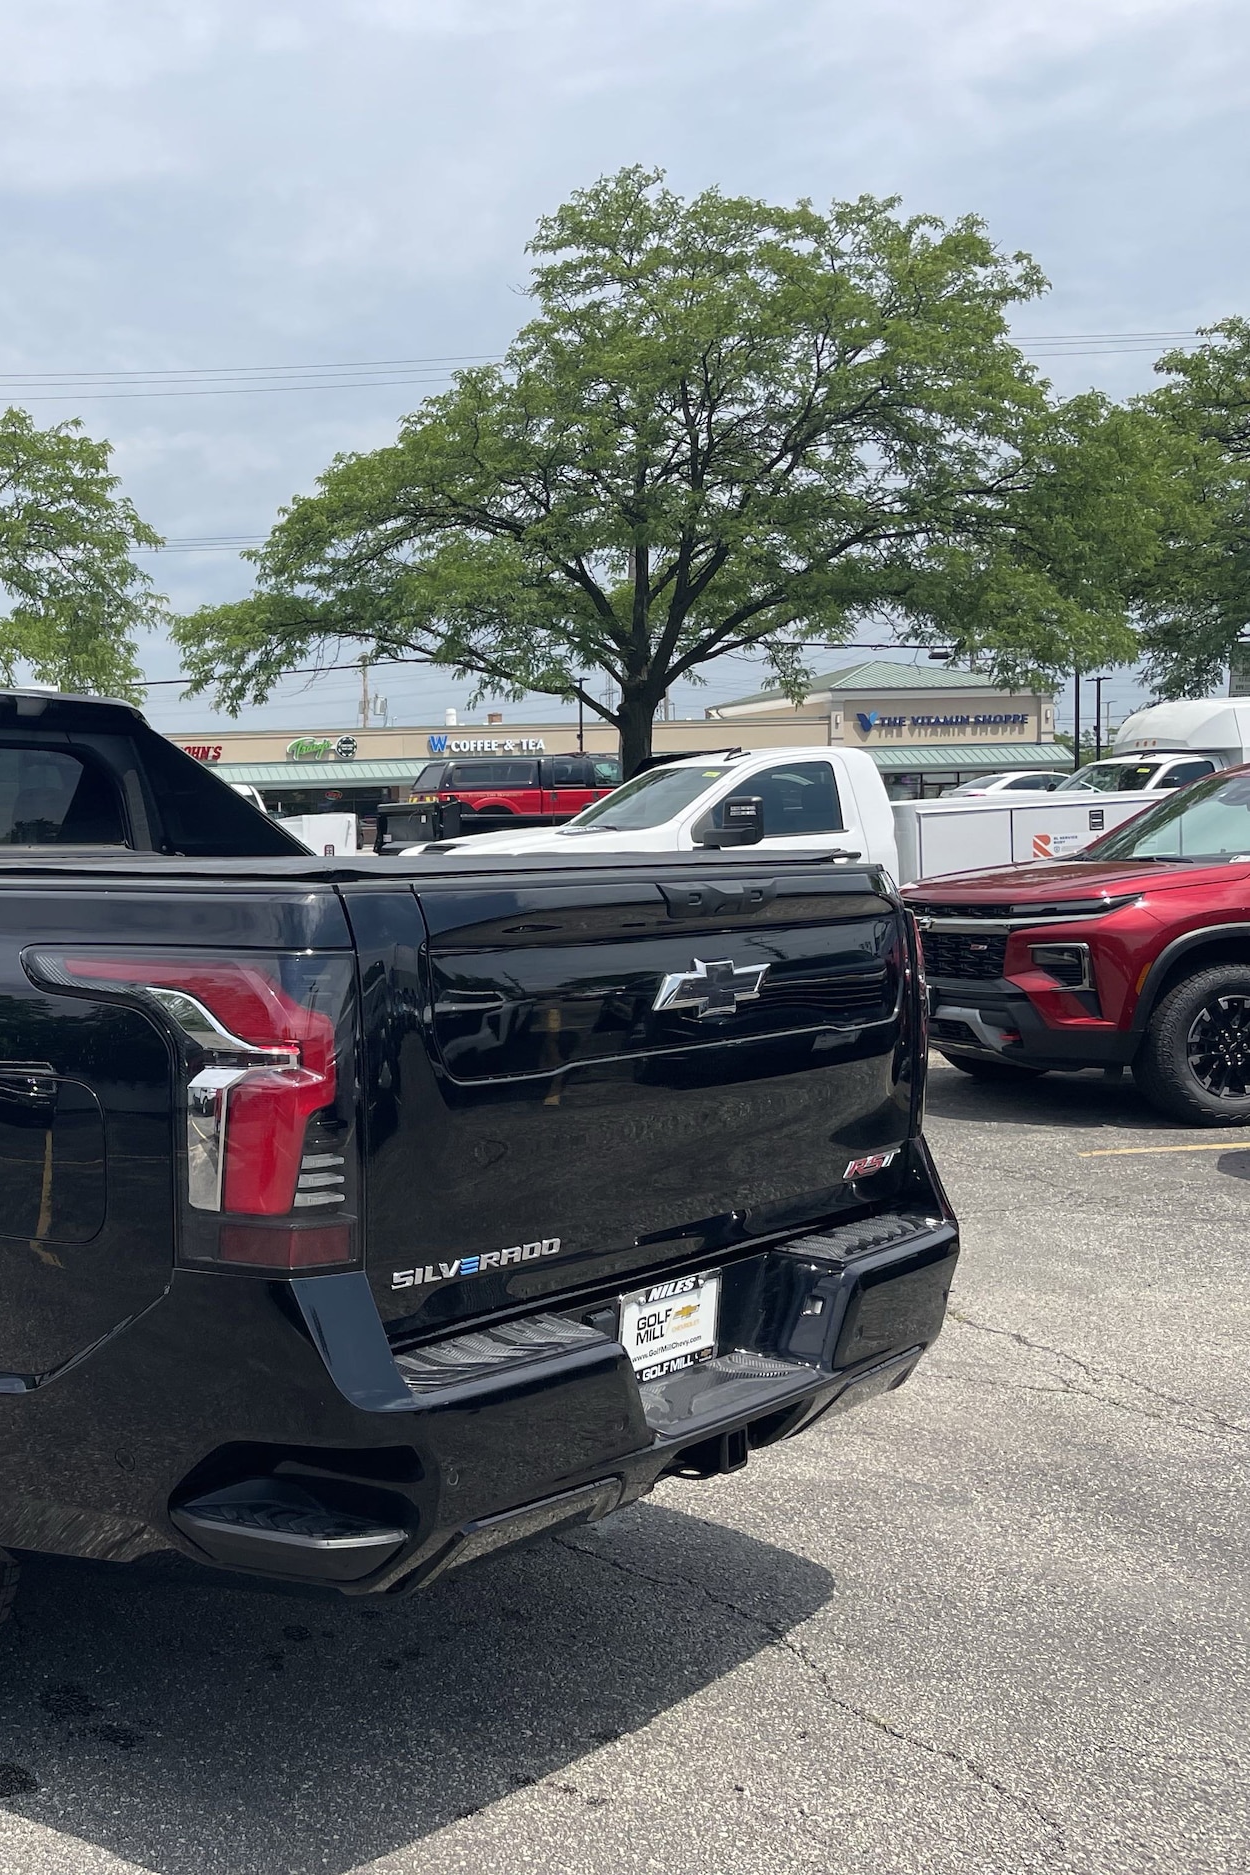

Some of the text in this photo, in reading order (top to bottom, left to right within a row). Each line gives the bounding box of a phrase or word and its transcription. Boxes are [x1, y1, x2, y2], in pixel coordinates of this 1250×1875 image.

[880, 714, 1029, 727] THE VITAMIN SHOPPE
[182, 746, 222, 760] OHN'S
[429, 735, 545, 752] W COFFEE & TEA
[843, 1148, 901, 1179] RST
[391, 1237, 562, 1290] SILVERADO
[647, 1276, 697, 1303] NILES
[636, 1308, 673, 1332] GOLF
[635, 1325, 665, 1346] MILL
[632, 1335, 702, 1363] www.GolfMillChevy.com
[642, 1354, 694, 1382] GOLF MILL
